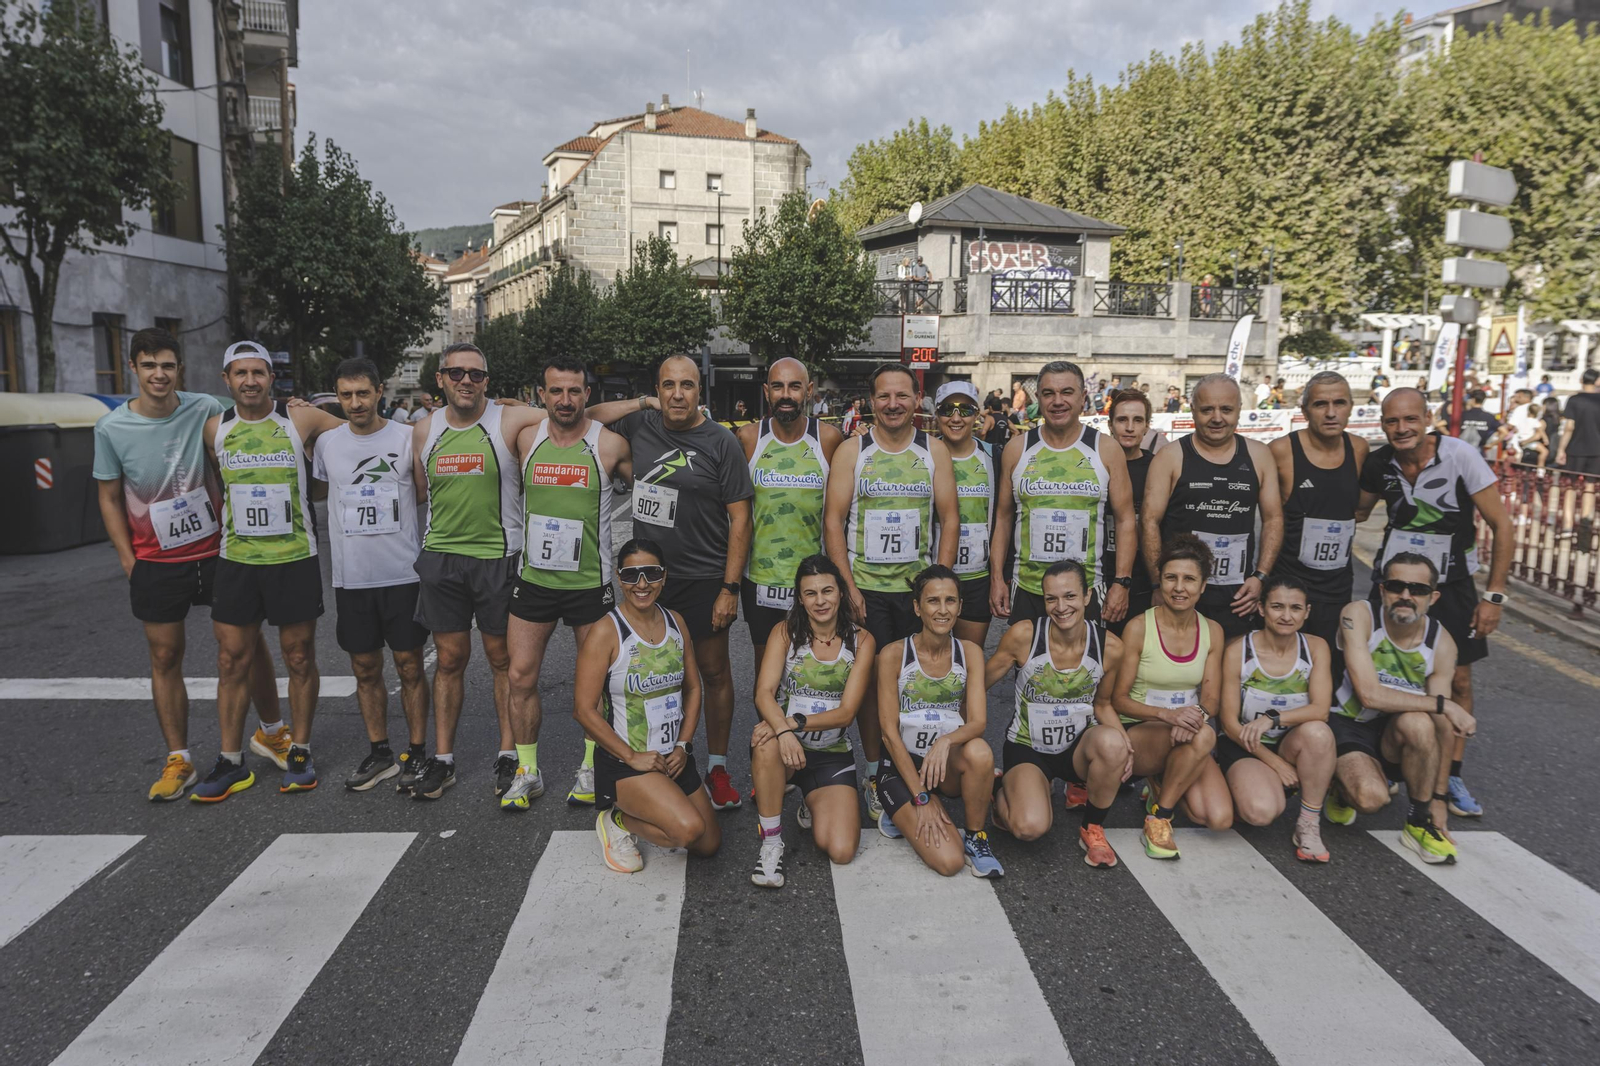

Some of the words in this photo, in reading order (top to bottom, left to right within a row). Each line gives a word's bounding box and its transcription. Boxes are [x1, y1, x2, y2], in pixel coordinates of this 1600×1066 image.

[969, 240, 1051, 272] SOTER
[1230, 341, 1241, 360] chc
[438, 454, 482, 464] mandarina
[534, 476, 558, 484] home
[535, 465, 586, 477] mandarina
[754, 469, 823, 486] Natursueño
[859, 479, 931, 496] Natursueño
[1020, 478, 1100, 495] Natursueño
[357, 506, 377, 526] 79
[637, 497, 660, 518] 902
[169, 512, 202, 538] 446
[246, 508, 268, 527] 90
[541, 540, 553, 560] 5
[880, 534, 901, 554] 75
[1043, 532, 1066, 553] 85
[1313, 542, 1340, 561] 193
[955, 546, 970, 565] 8
[1041, 724, 1076, 746] 678
